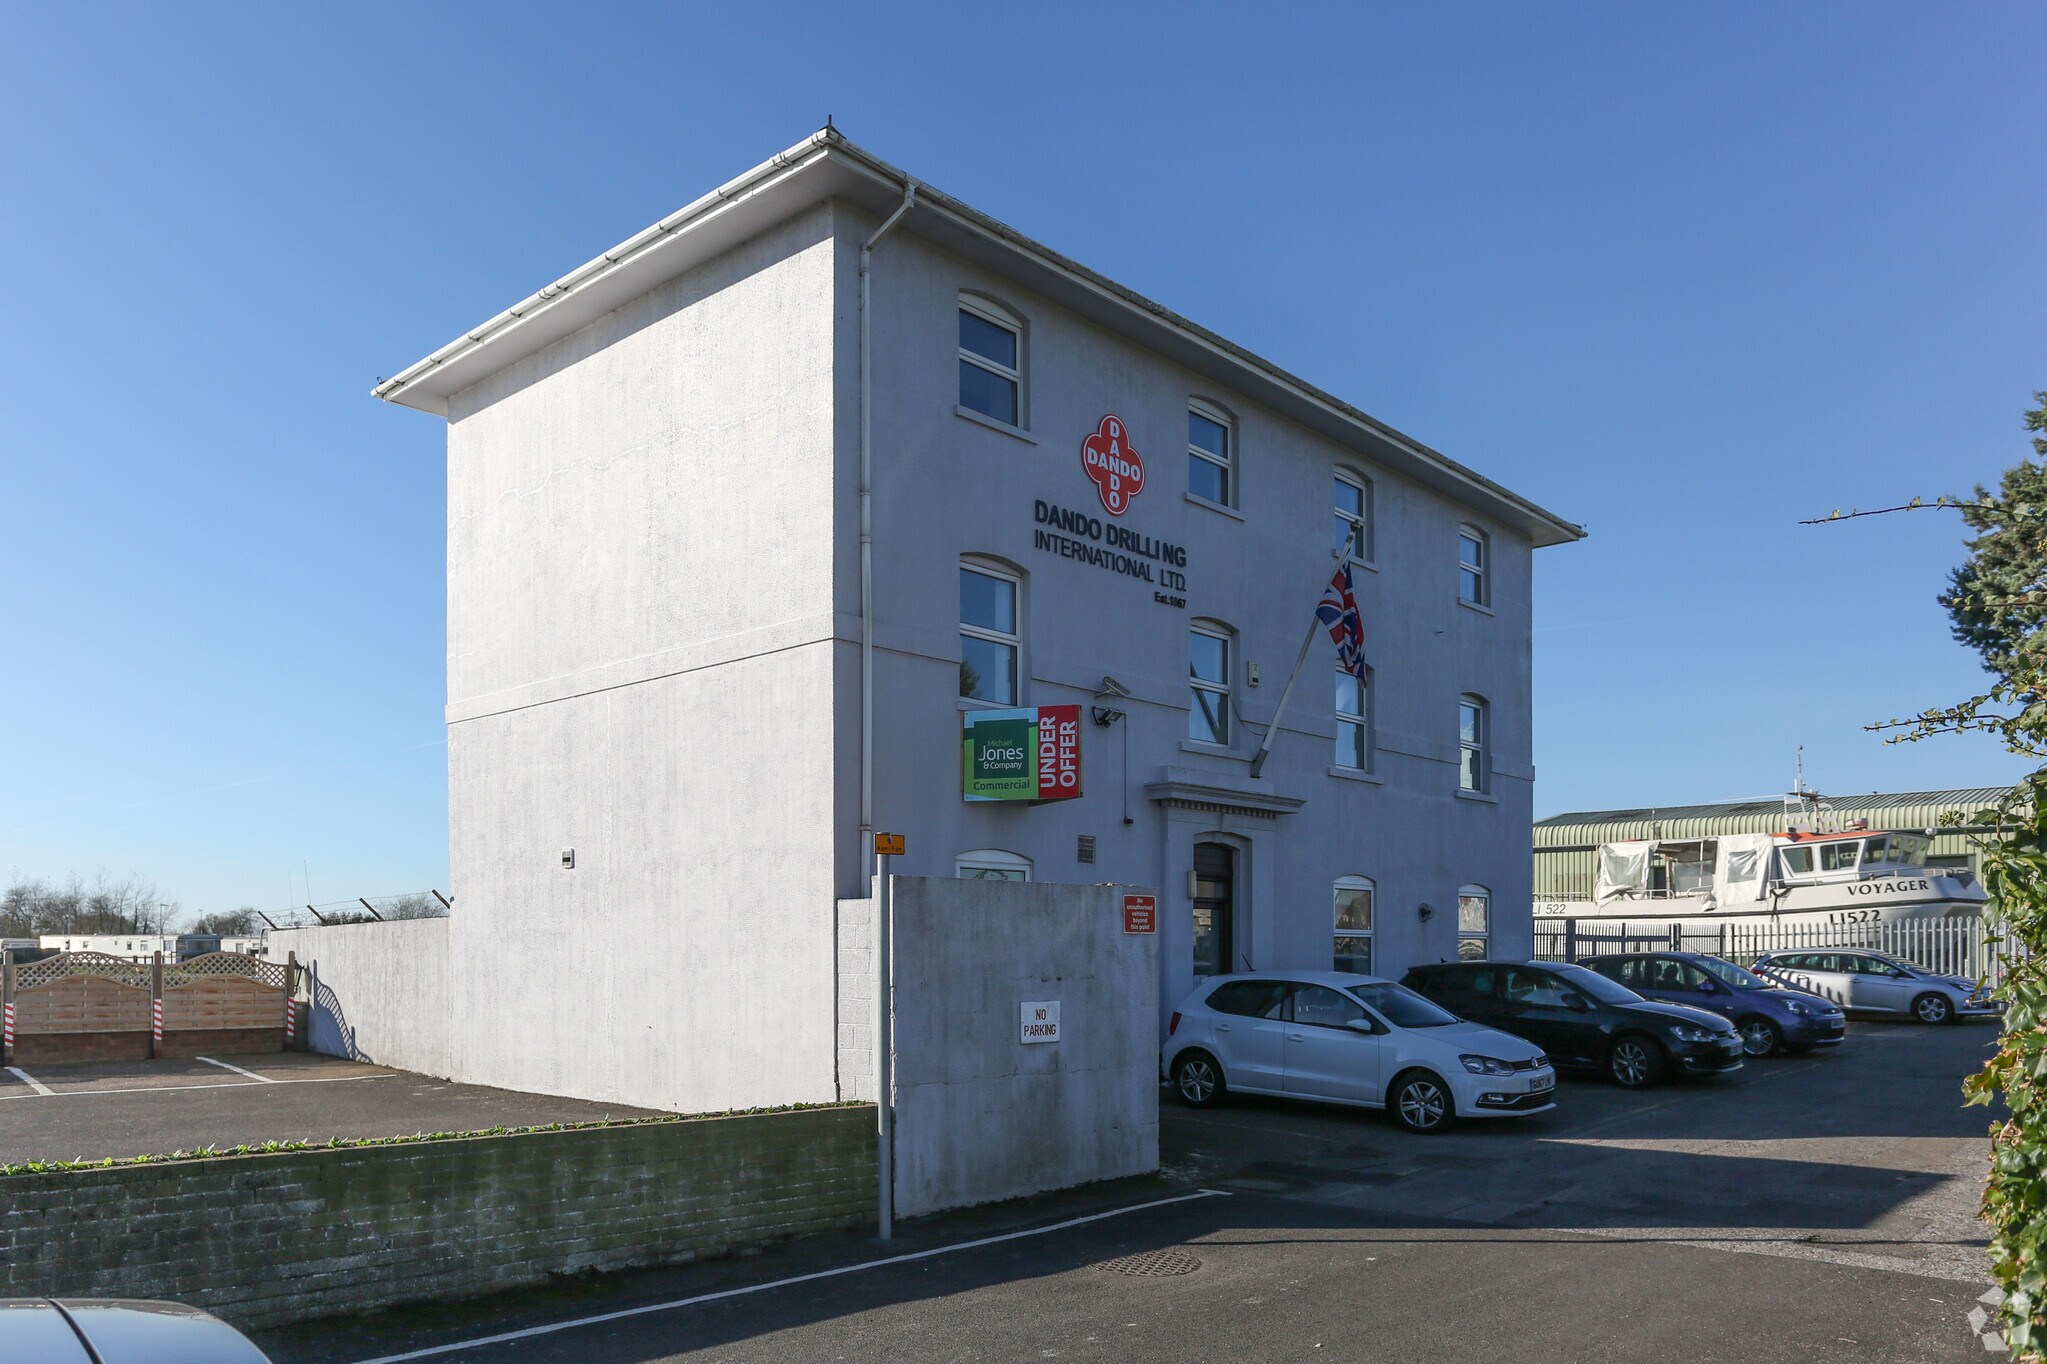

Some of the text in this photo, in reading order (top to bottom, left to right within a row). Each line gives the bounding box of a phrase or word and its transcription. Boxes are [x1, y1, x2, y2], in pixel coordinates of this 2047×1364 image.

[1087, 447, 1140, 482] DANDO
[1034, 499, 1187, 568] DANDO DRILLING
[1034, 528, 1187, 592] INTERNATIONAL LTD.
[987, 739, 1013, 747] Michael
[978, 745, 1024, 762] Jones
[1040, 715, 1056, 788] UNDER
[1060, 720, 1076, 787] OFFER
[974, 780, 1030, 790] Commercial
[1847, 880, 1929, 895] VOYAGER
[1546, 904, 1566, 914] 522
[1036, 1008, 1046, 1020] NO
[1023, 1023, 1057, 1037] PARKING
